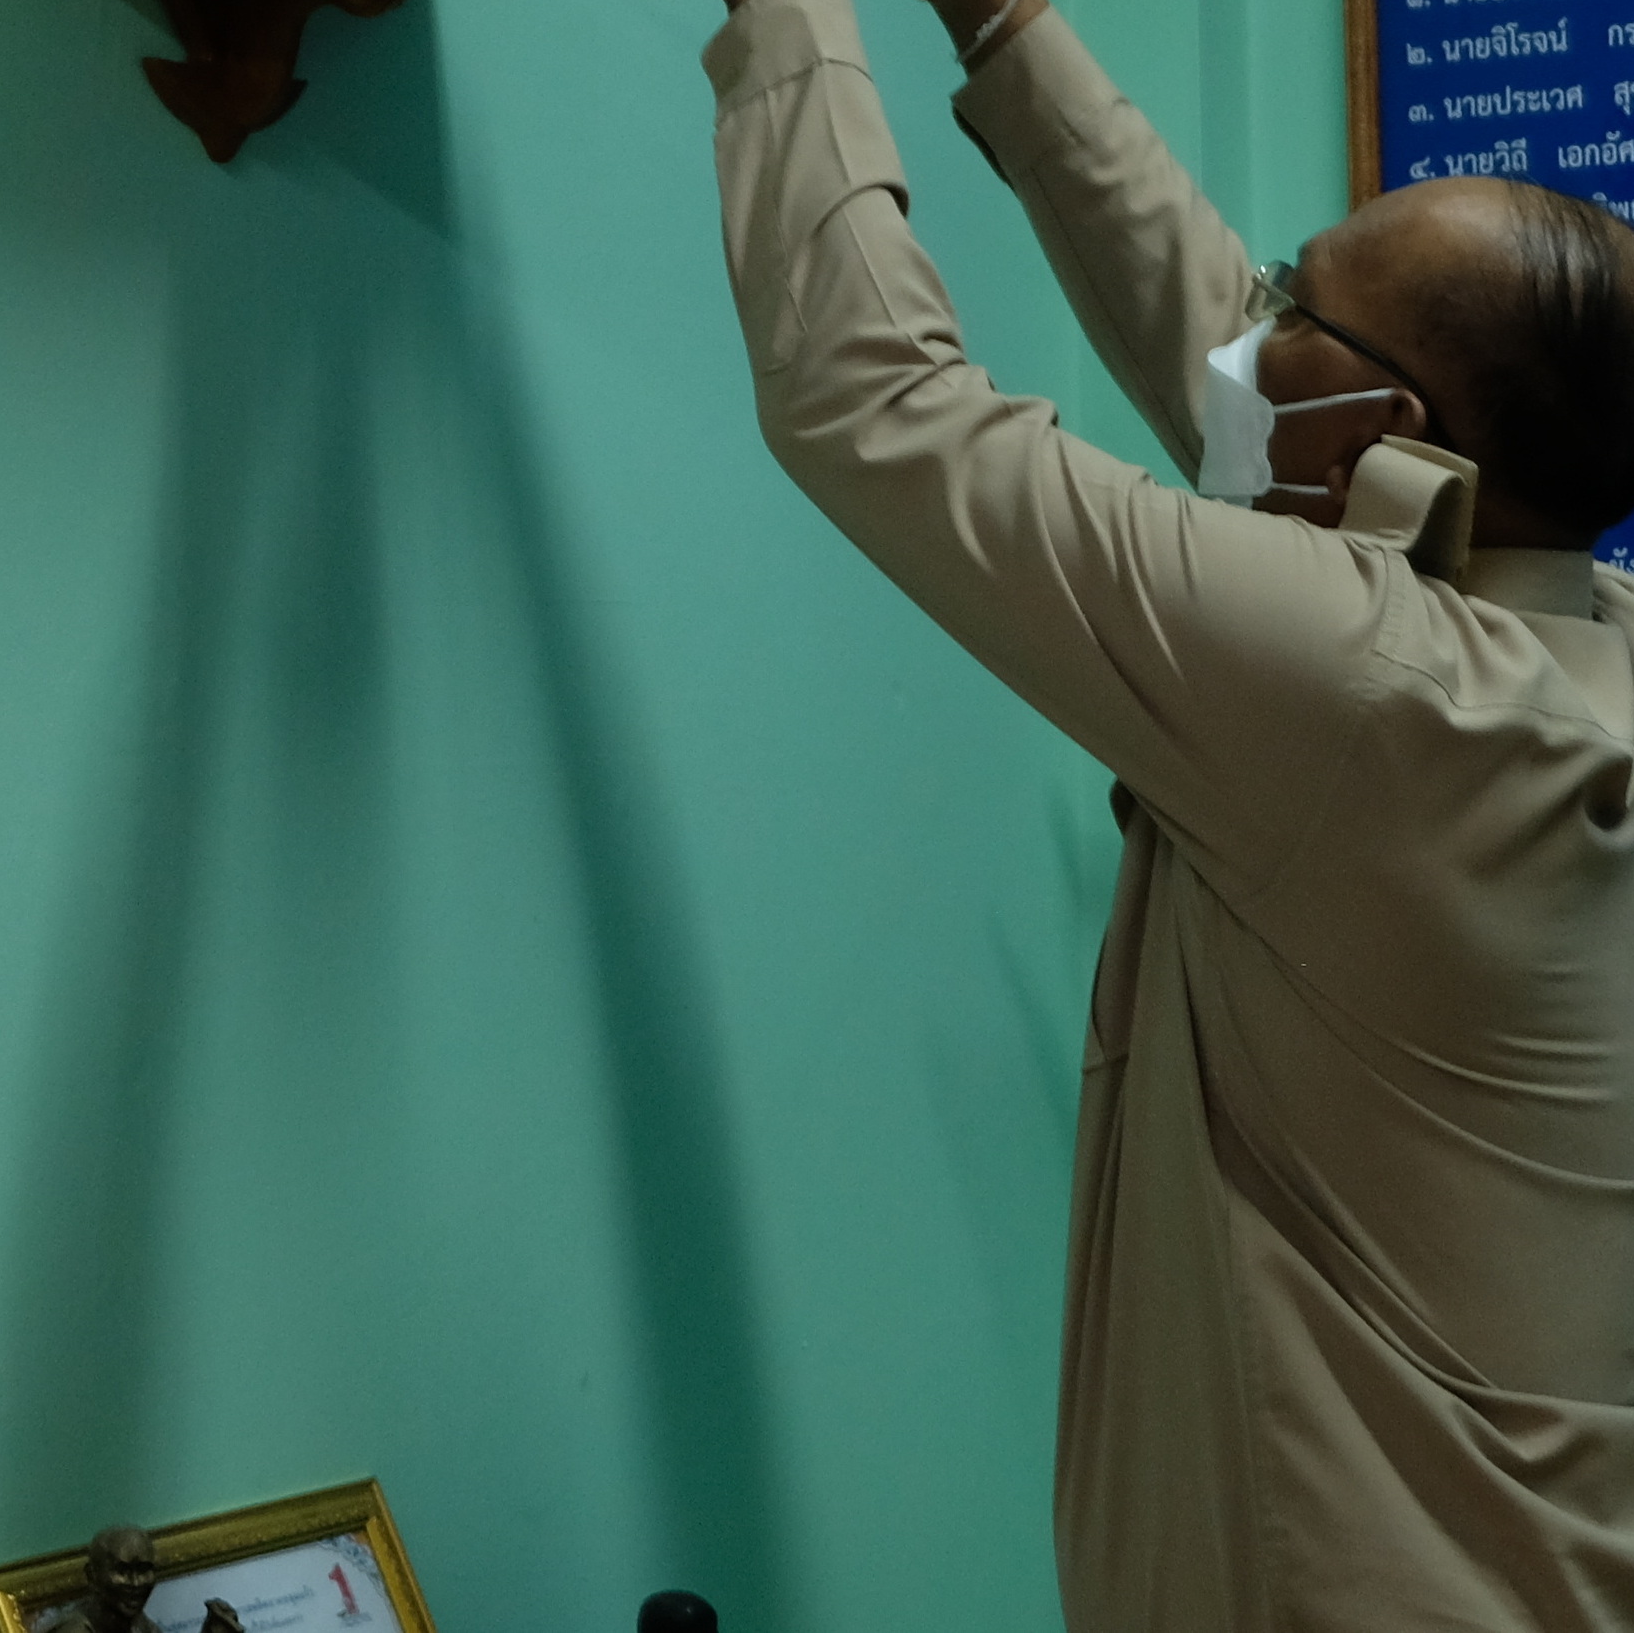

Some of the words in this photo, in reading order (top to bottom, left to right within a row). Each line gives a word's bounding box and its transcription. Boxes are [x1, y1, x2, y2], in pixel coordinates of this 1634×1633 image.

[1406, 43, 1433, 65] ๒.
[1441, 16, 1569, 62] นายจิโรจน์
[1408, 104, 1435, 122] ๓.
[1443, 84, 1584, 119] นายประเวศ
[1409, 156, 1437, 180] ๔.
